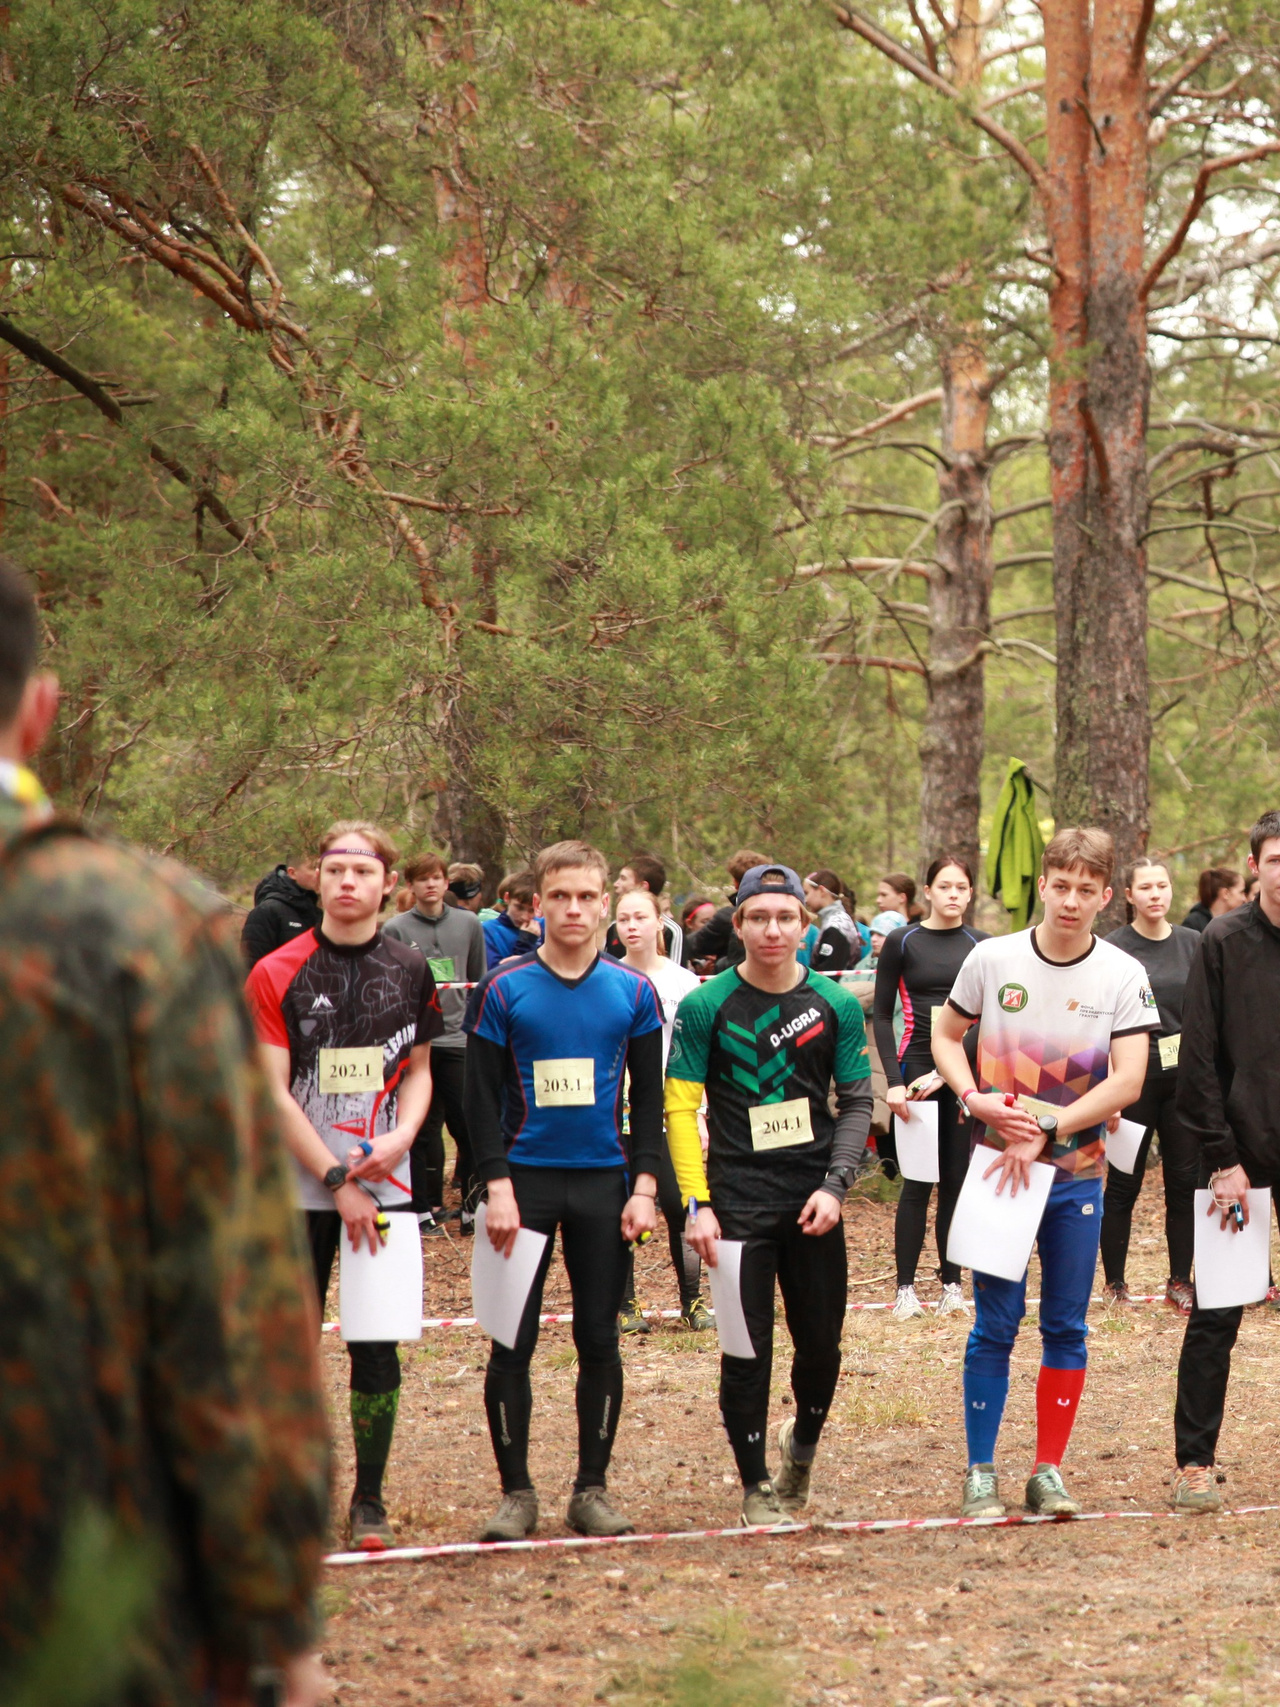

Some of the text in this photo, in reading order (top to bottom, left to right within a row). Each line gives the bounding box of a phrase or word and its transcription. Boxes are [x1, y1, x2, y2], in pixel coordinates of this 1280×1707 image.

[330, 1063, 370, 1078] 202.1
[543, 1078, 581, 1093] 203.1
[763, 1116, 801, 1135] 204.1
